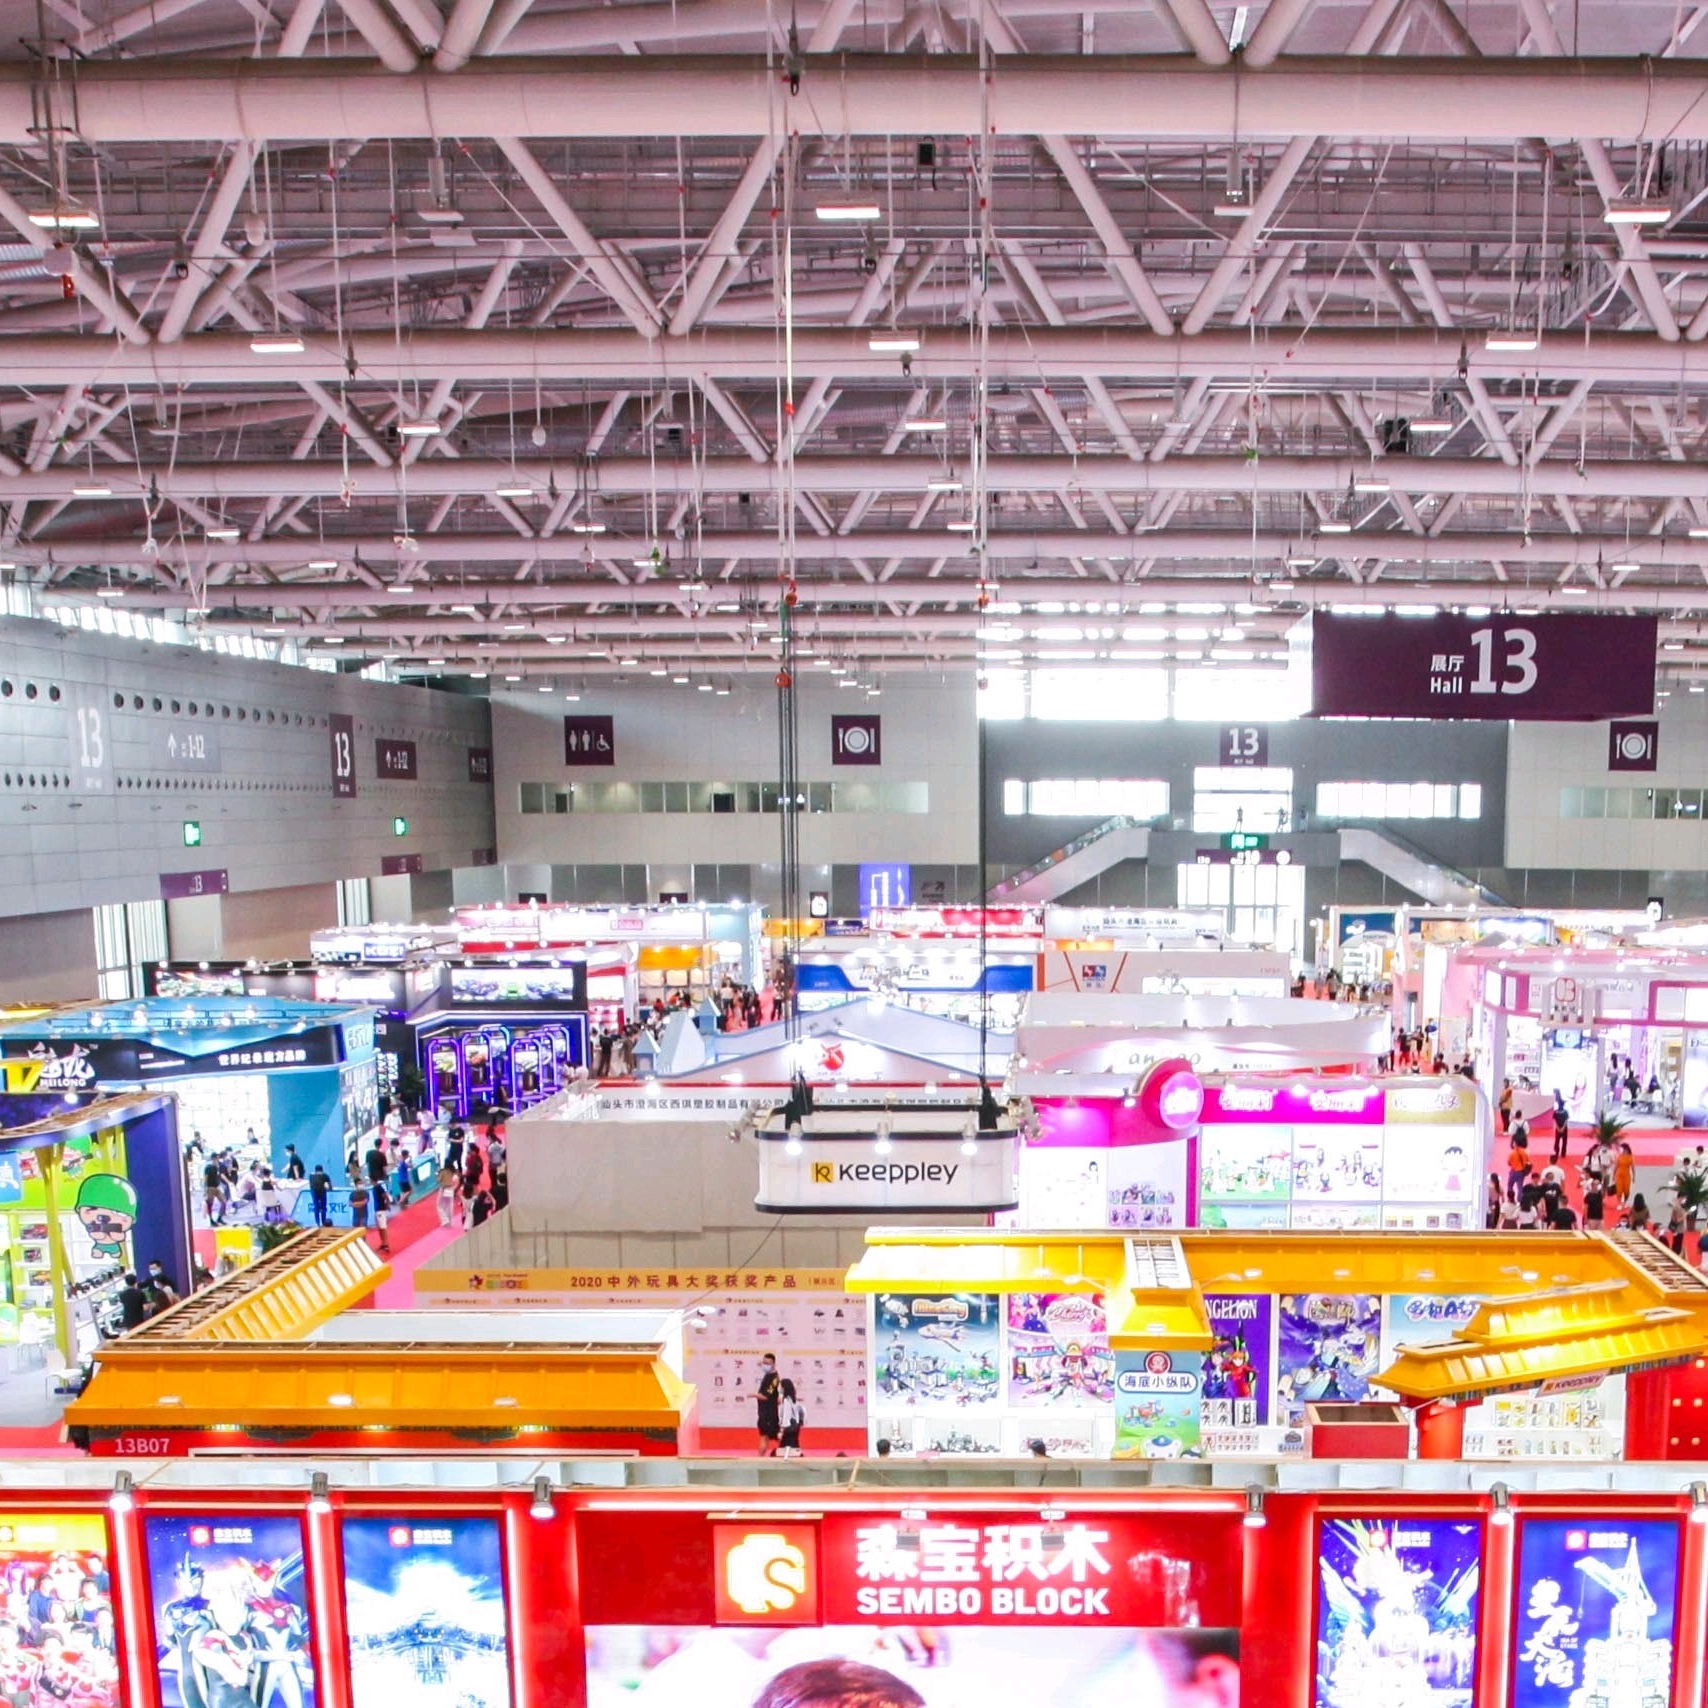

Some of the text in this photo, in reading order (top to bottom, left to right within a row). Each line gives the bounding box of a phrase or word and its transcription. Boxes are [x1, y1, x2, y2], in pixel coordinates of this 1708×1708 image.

[1430, 654, 1464, 674] 展厅
[1470, 628, 1538, 695] 13
[1430, 677, 1463, 695] Hall
[78, 707, 103, 769] 13
[1229, 727, 1260, 757] 13
[335, 732, 350, 777] 13
[570, 1275, 604, 1288] 2020
[1124, 1375, 1193, 1389] 海底小纵队
[114, 1437, 171, 1454] 13B07
[856, 1524, 1112, 1582] 森宝积木
[856, 1588, 1110, 1616] SEMBO BLOCK
